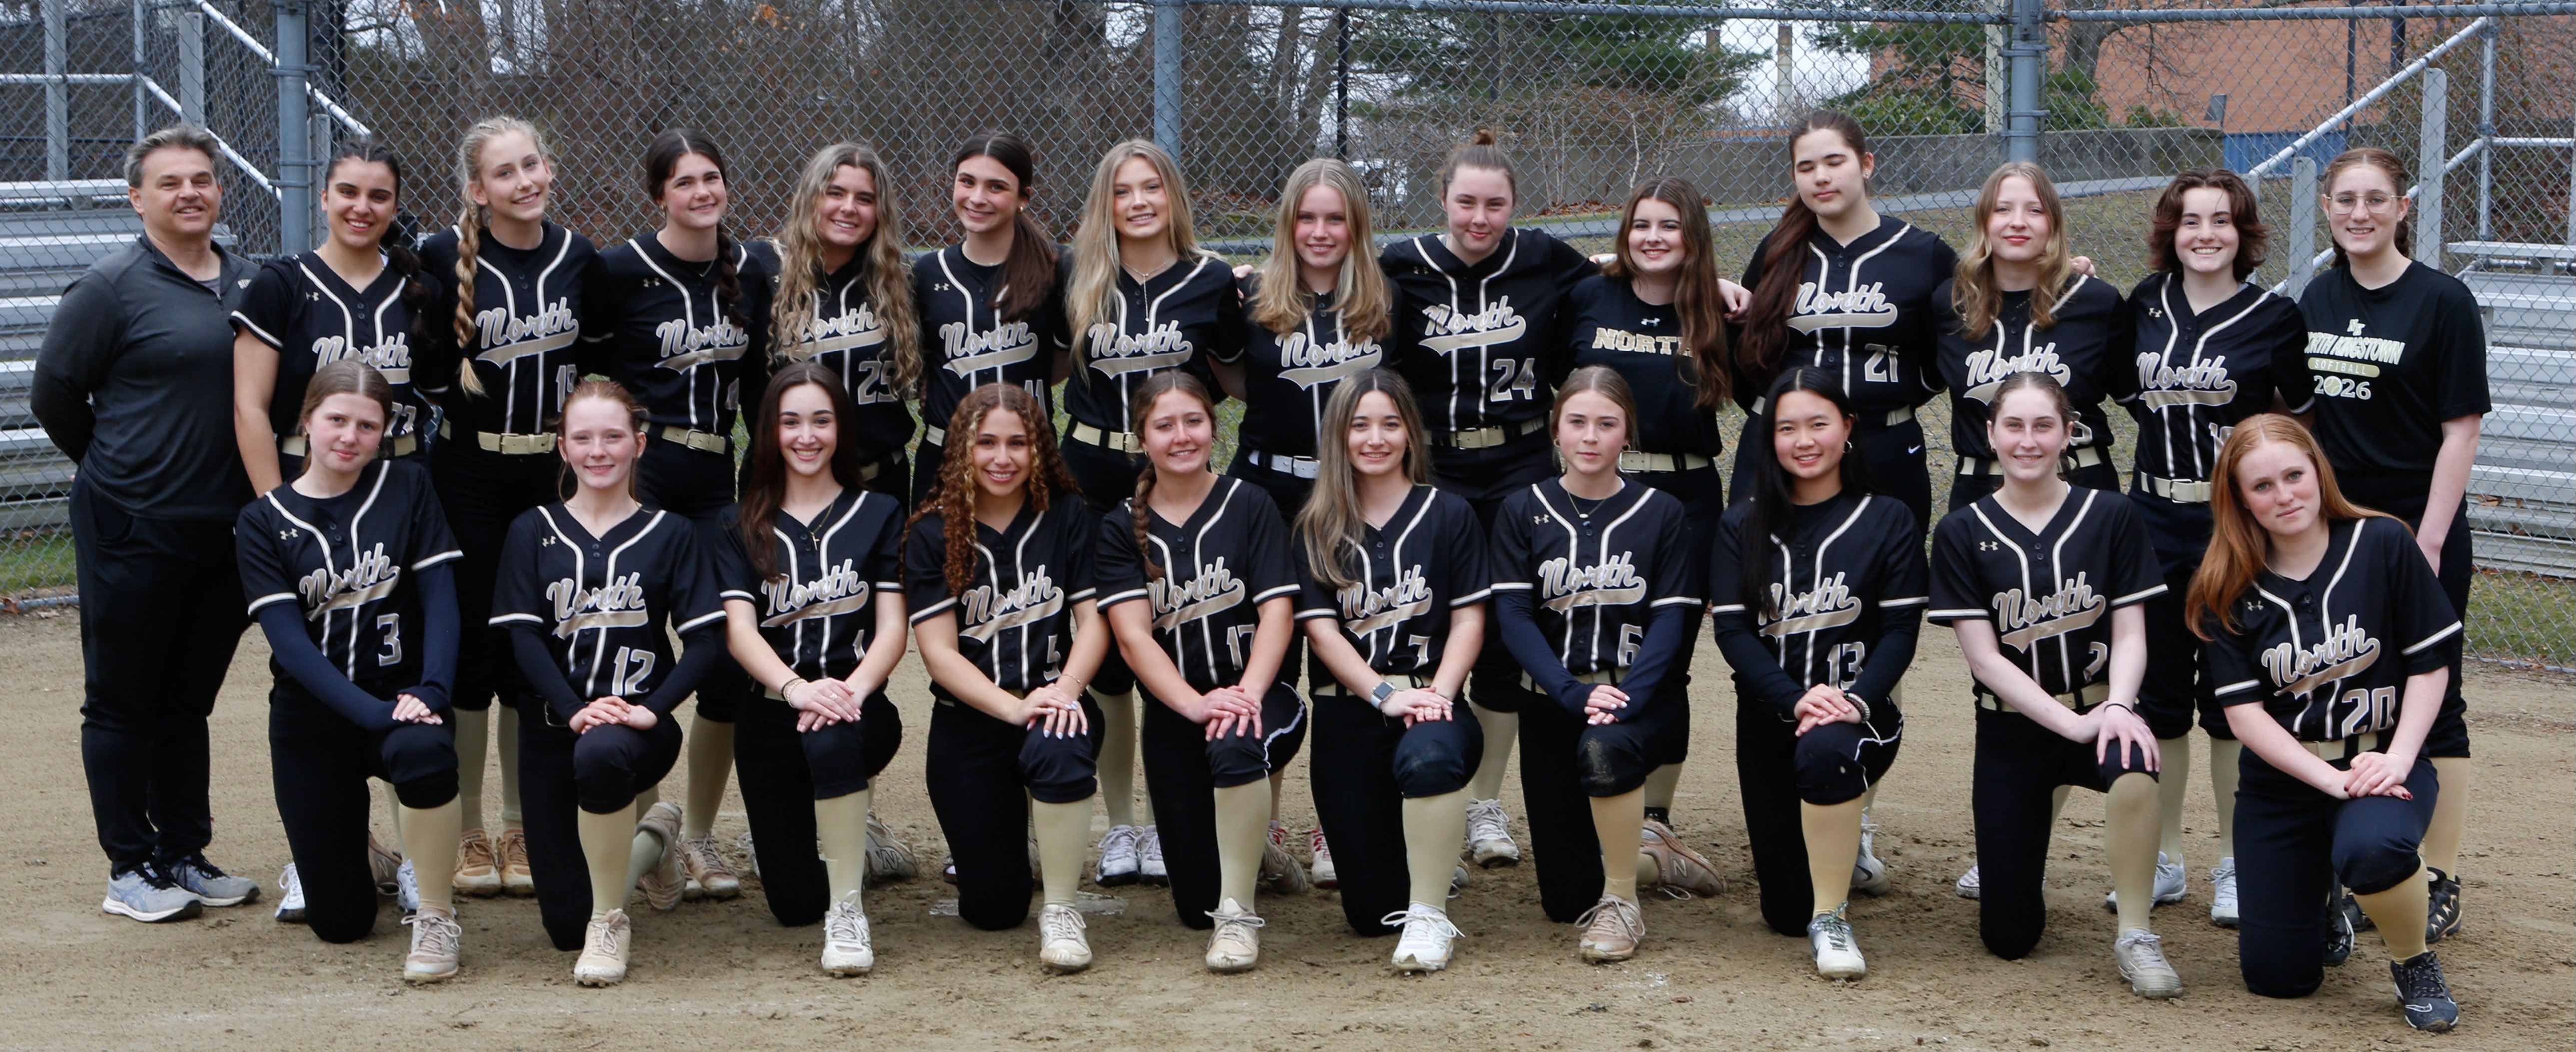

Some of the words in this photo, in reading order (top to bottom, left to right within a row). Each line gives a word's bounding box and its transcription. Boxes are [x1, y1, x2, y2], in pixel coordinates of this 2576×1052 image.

[1422, 295, 1527, 336] North
[1791, 282, 1897, 315] North
[475, 297, 579, 349] North
[656, 315, 749, 358] North
[939, 321, 1038, 358] North
[1088, 320, 1193, 358] North
[1864, 343, 1899, 382] 21
[1965, 342, 2070, 387] North
[2136, 352, 2237, 391] North
[2314, 359, 2366, 375] SOFTBALL
[2329, 336, 2406, 365] KINGSTOWN
[858, 360, 898, 405] 25
[1490, 358, 1536, 402] 24
[2313, 375, 2371, 400] 2026
[299, 542, 400, 607] North
[546, 572, 647, 622] North
[761, 558, 869, 616] North
[962, 564, 1064, 625] North
[1146, 556, 1245, 619] North
[1337, 564, 1433, 620] North
[1538, 551, 1646, 599] North
[1993, 571, 2106, 632] North
[377, 613, 401, 666] 3
[1043, 634, 1061, 681] 5
[1226, 623, 1256, 671] 17
[1408, 635, 1431, 669] 7
[1617, 623, 1643, 667] 6
[2261, 614, 2380, 687] North
[612, 646, 655, 697] 12
[1827, 641, 1865, 691] 13
[2341, 685, 2396, 738] 20
